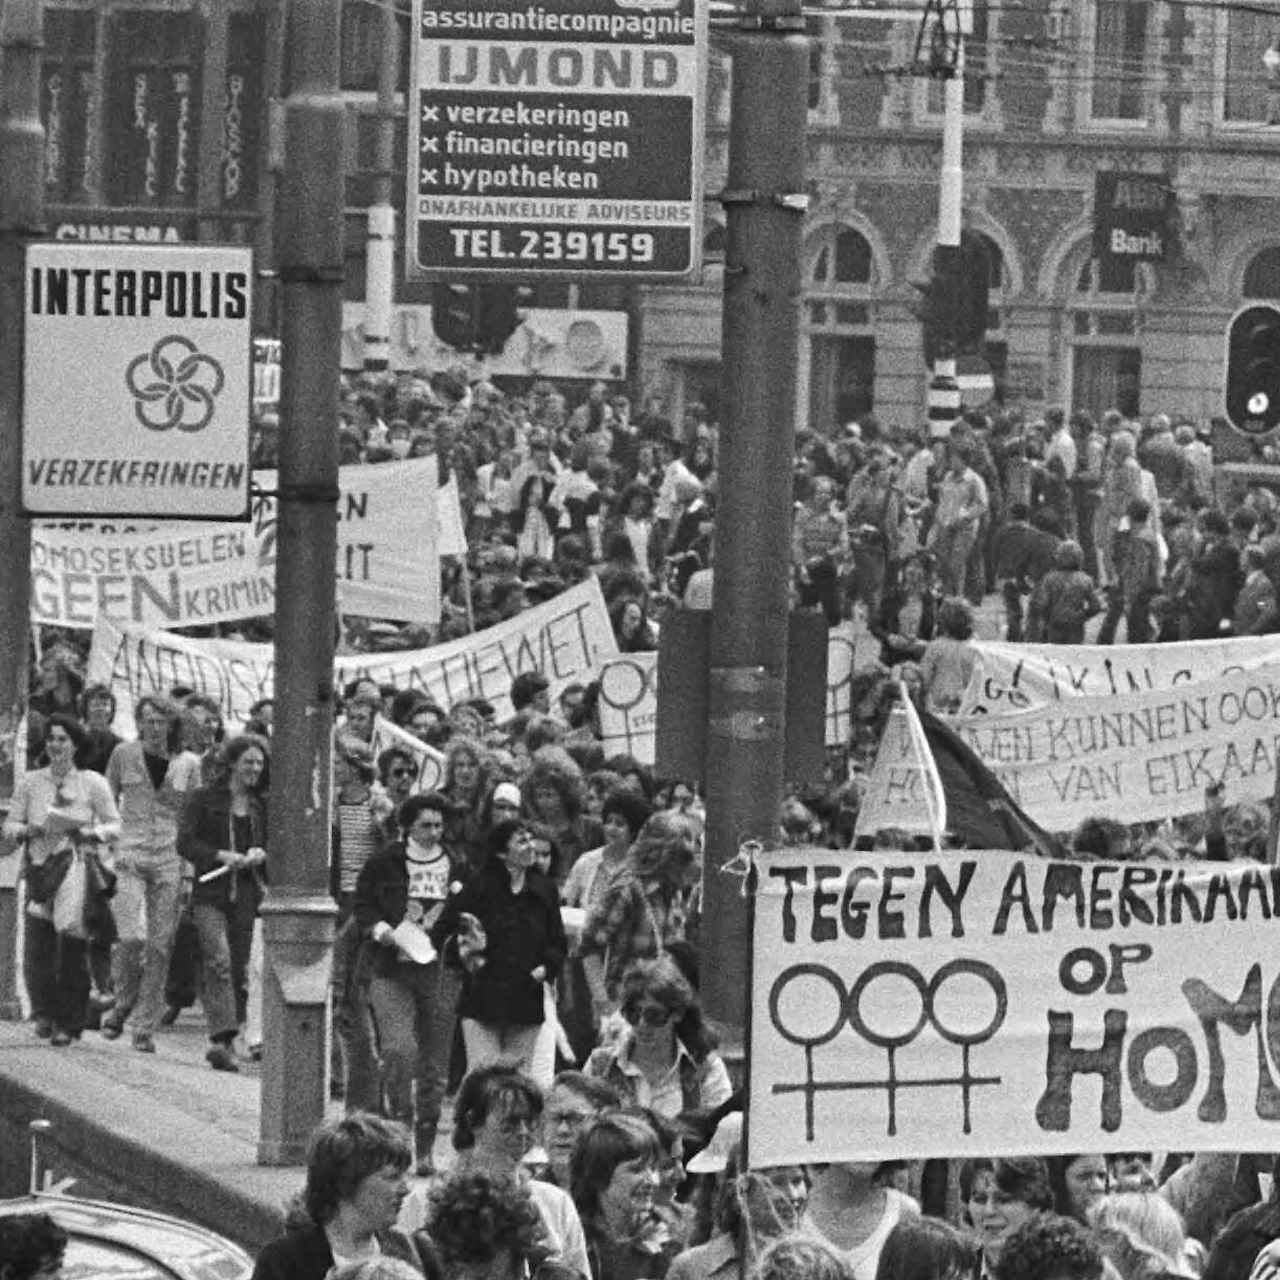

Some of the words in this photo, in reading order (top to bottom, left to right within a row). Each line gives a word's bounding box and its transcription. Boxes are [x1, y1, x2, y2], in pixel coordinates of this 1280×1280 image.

[423, 8, 695, 39] assurantiecompagnie
[437, 46, 679, 89] IJMOND
[447, 101, 630, 132] verzekeringen
[446, 131, 630, 163] financieringen
[445, 162, 599, 193] hypotheken
[418, 199, 578, 219] ONAFHANKELIJKE
[586, 201, 692, 221] ADVISEURS
[1110, 228, 1162, 255] Bank
[31, 267, 246, 319] INTERPOLIS
[28, 458, 246, 490] VERZEKERINGEN
[31, 569, 181, 622] GEEN
[1048, 697, 1210, 760] KUNNEN
[1048, 764, 1122, 802] VAN
[769, 861, 977, 943] TEGEN
[1059, 943, 1154, 996] OP
